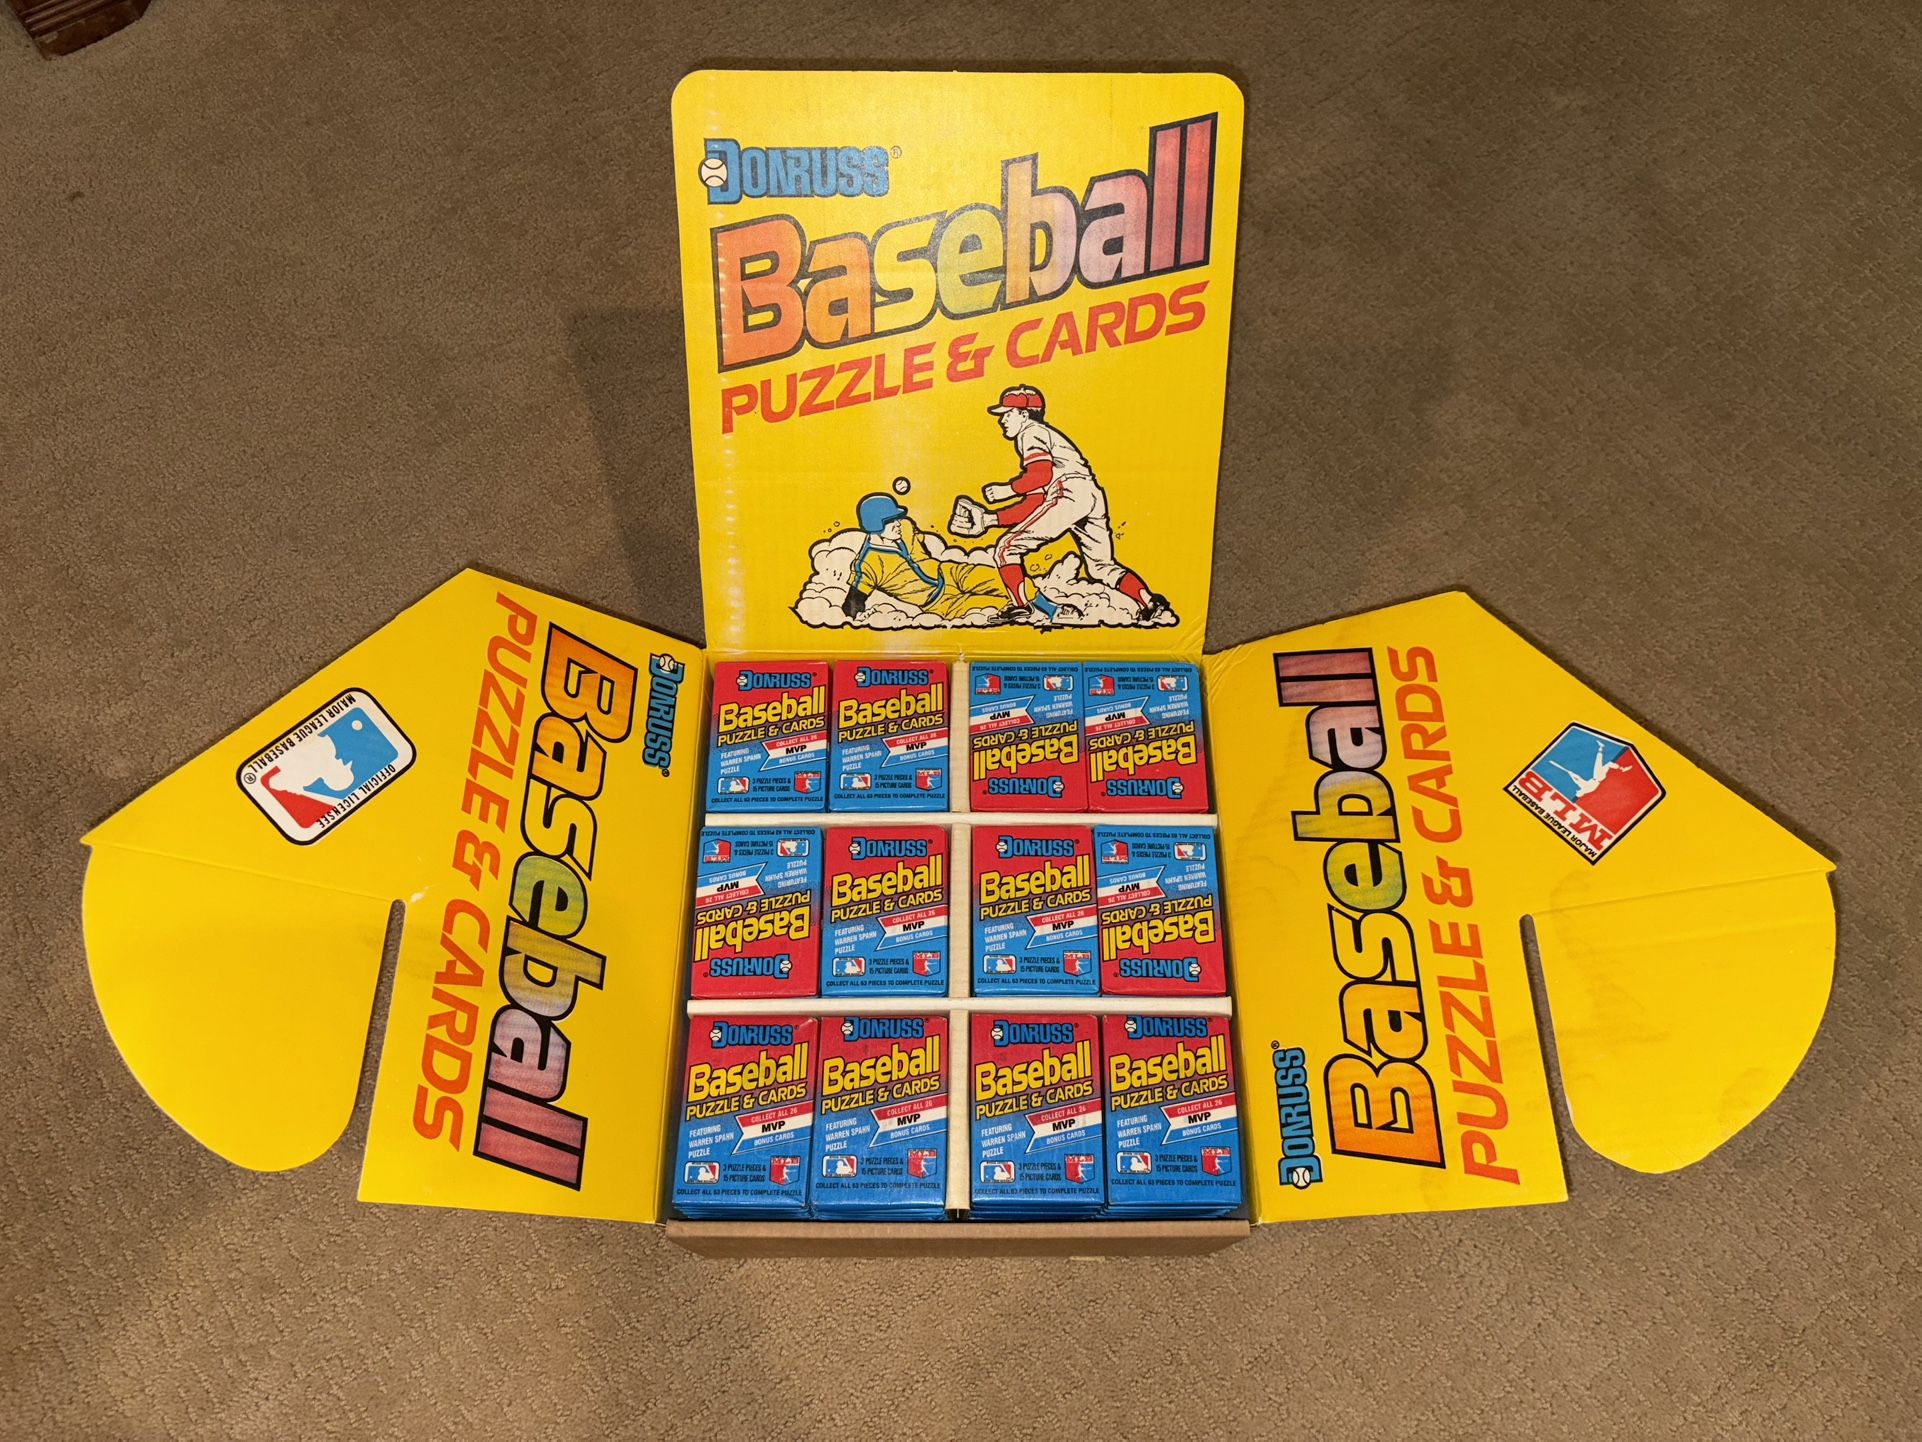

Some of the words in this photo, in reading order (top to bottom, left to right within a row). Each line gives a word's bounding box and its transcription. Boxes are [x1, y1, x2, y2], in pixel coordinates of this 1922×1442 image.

[699, 138, 890, 204] DONRUSS
[710, 112, 1218, 373] Baseball
[722, 342, 936, 434] PUZZLE
[947, 333, 994, 383] &
[1007, 280, 1210, 369] CARDS
[736, 671, 812, 691] DONRUSS
[855, 667, 929, 687] DONRUSS
[329, 693, 357, 719] MAJOR
[461, 592, 538, 833] PUZZLE
[642, 653, 686, 769] DONRUSS
[718, 685, 826, 732] Baseball
[838, 683, 943, 728] Baseball
[989, 710, 1010, 719] MVP
[1104, 711, 1125, 720] MVP
[293, 714, 329, 742] LEAGUE
[717, 726, 766, 746] PUZZLE
[768, 724, 781, 737] &
[782, 716, 826, 733] CARDS
[838, 722, 885, 742] PUZZLE
[888, 720, 901, 733] &
[902, 713, 945, 730] CARDS
[972, 731, 1014, 747] CARDS
[1015, 728, 1028, 741] &
[1030, 720, 1077, 739] PUZZLE
[1131, 729, 1144, 742] &
[1146, 720, 1194, 740] PUZZLE
[785, 745, 807, 754] MVP
[906, 742, 927, 751] MVP
[1087, 732, 1130, 749] CARDS
[1388, 646, 1463, 844] CARDS
[247, 737, 296, 773] BASEBALL
[973, 733, 1078, 778] Baseball
[1088, 734, 1196, 781] Baseball
[358, 764, 396, 795] OFFICIAL
[987, 775, 1062, 797] DONRUSS
[1105, 776, 1182, 798] DONRUSS
[316, 793, 360, 829] LICENSEE
[1512, 785, 1546, 815] BASEBALL
[1518, 771, 1614, 851] MLB
[1543, 811, 1572, 837] LEAGUE
[849, 837, 927, 860] DONRUSS
[996, 835, 1074, 858] DONRUSS
[1570, 833, 1597, 858] MAJOR
[452, 832, 501, 893] &
[716, 880, 739, 891] MVP
[831, 854, 942, 906] Baseball
[980, 854, 1090, 904] Baseball
[1117, 882, 1139, 891] MVP
[1424, 856, 1474, 909] &
[473, 622, 639, 1191] Baseball
[742, 900, 757, 915] &
[759, 889, 810, 912] PUZZLE
[830, 899, 881, 922] PUZZLE
[883, 897, 897, 912] &
[898, 888, 944, 908] CARDS
[980, 898, 1030, 919] PUZZLE
[1032, 896, 1046, 911] &
[1047, 888, 1092, 907] CARDS
[1146, 902, 1160, 916] &
[1162, 894, 1212, 914] PUZZLE
[1273, 647, 1446, 1169] Baseball
[694, 903, 742, 924] CARDS
[1041, 913, 1064, 922] COLLECT
[1099, 905, 1145, 924] CARDS
[693, 905, 809, 961] Baseball
[902, 921, 925, 932] MVP
[985, 924, 1014, 934] FEATURING
[985, 933, 1008, 943] WARREN
[1009, 930, 1027, 939] SPAHN
[1047, 933, 1064, 942] BONUS
[1066, 930, 1083, 938] CARDS
[1052, 921, 1074, 931] MVP
[1101, 909, 1214, 960] Baseball
[986, 943, 1005, 952] PUZZLE
[708, 952, 791, 977] DONRUSS
[1118, 956, 1200, 981] DONRUSS
[413, 899, 491, 1152] CARDS
[709, 1021, 794, 1048] DONRUSS
[841, 1015, 924, 1042] DONRUSS
[992, 1020, 1074, 1047] DONRUSS
[1125, 1013, 1208, 1039] DONRUSS
[1109, 1035, 1227, 1092] Baseball
[1429, 919, 1521, 1185] PUZZLE
[687, 1042, 809, 1102] Baseball
[822, 1035, 940, 1096] Baseball
[975, 1040, 1092, 1101] Baseball
[685, 1095, 741, 1120] PUZZLE
[742, 1092, 758, 1109] &
[758, 1082, 808, 1105] CARDS
[821, 1088, 875, 1114] PUZZLE
[877, 1085, 892, 1102] &
[893, 1075, 942, 1098] CARDS
[976, 1093, 1028, 1119] PUZZLE
[1031, 1091, 1045, 1108] &
[1046, 1080, 1094, 1104] CARDS
[1111, 1085, 1163, 1110] PUZZLE
[1166, 1083, 1180, 1100] &
[1181, 1074, 1229, 1096] CARDS
[751, 1112, 775, 1123] COLLECT
[777, 1110, 788, 1118] ALL
[886, 1105, 910, 1116] COLLECT
[1177, 1103, 1200, 1114] COLLECT
[1202, 1101, 1212, 1109] ALL
[1214, 1099, 1222, 1107] 26
[1188, 1112, 1211, 1124] MVP
[1273, 1046, 1323, 1190] DONRUSS
[689, 1125, 721, 1137] FEATURING
[761, 1121, 786, 1133] MVP
[826, 1118, 857, 1131] FEATURING
[897, 1113, 921, 1126] MVP
[982, 1124, 1012, 1136] FEATURING
[1052, 1119, 1075, 1131] MVP
[1117, 1115, 1148, 1127] FEATURING
[1118, 1127, 1142, 1138] WARREN
[1143, 1123, 1162, 1133] SPAHN
[1183, 1126, 1201, 1136] BONUS
[1203, 1123, 1222, 1132] CARDS
[689, 1136, 714, 1148] WARREN
[715, 1132, 734, 1143] SPAHN
[754, 1135, 774, 1146] BONUS
[775, 1132, 795, 1141] CARDS
[825, 1130, 850, 1142] WARREN
[851, 1125, 870, 1136] SPAHN
[891, 1128, 910, 1139] BONUS
[911, 1125, 930, 1134] CARDS
[982, 1135, 1006, 1148] WARREN
[1007, 1131, 1026, 1142] SPAHN
[1119, 1138, 1139, 1148] PUZZLE
[689, 1148, 710, 1158] PUZZLE
[826, 1141, 847, 1152] PUZZLE
[983, 1147, 1003, 1158] PUZZLE
